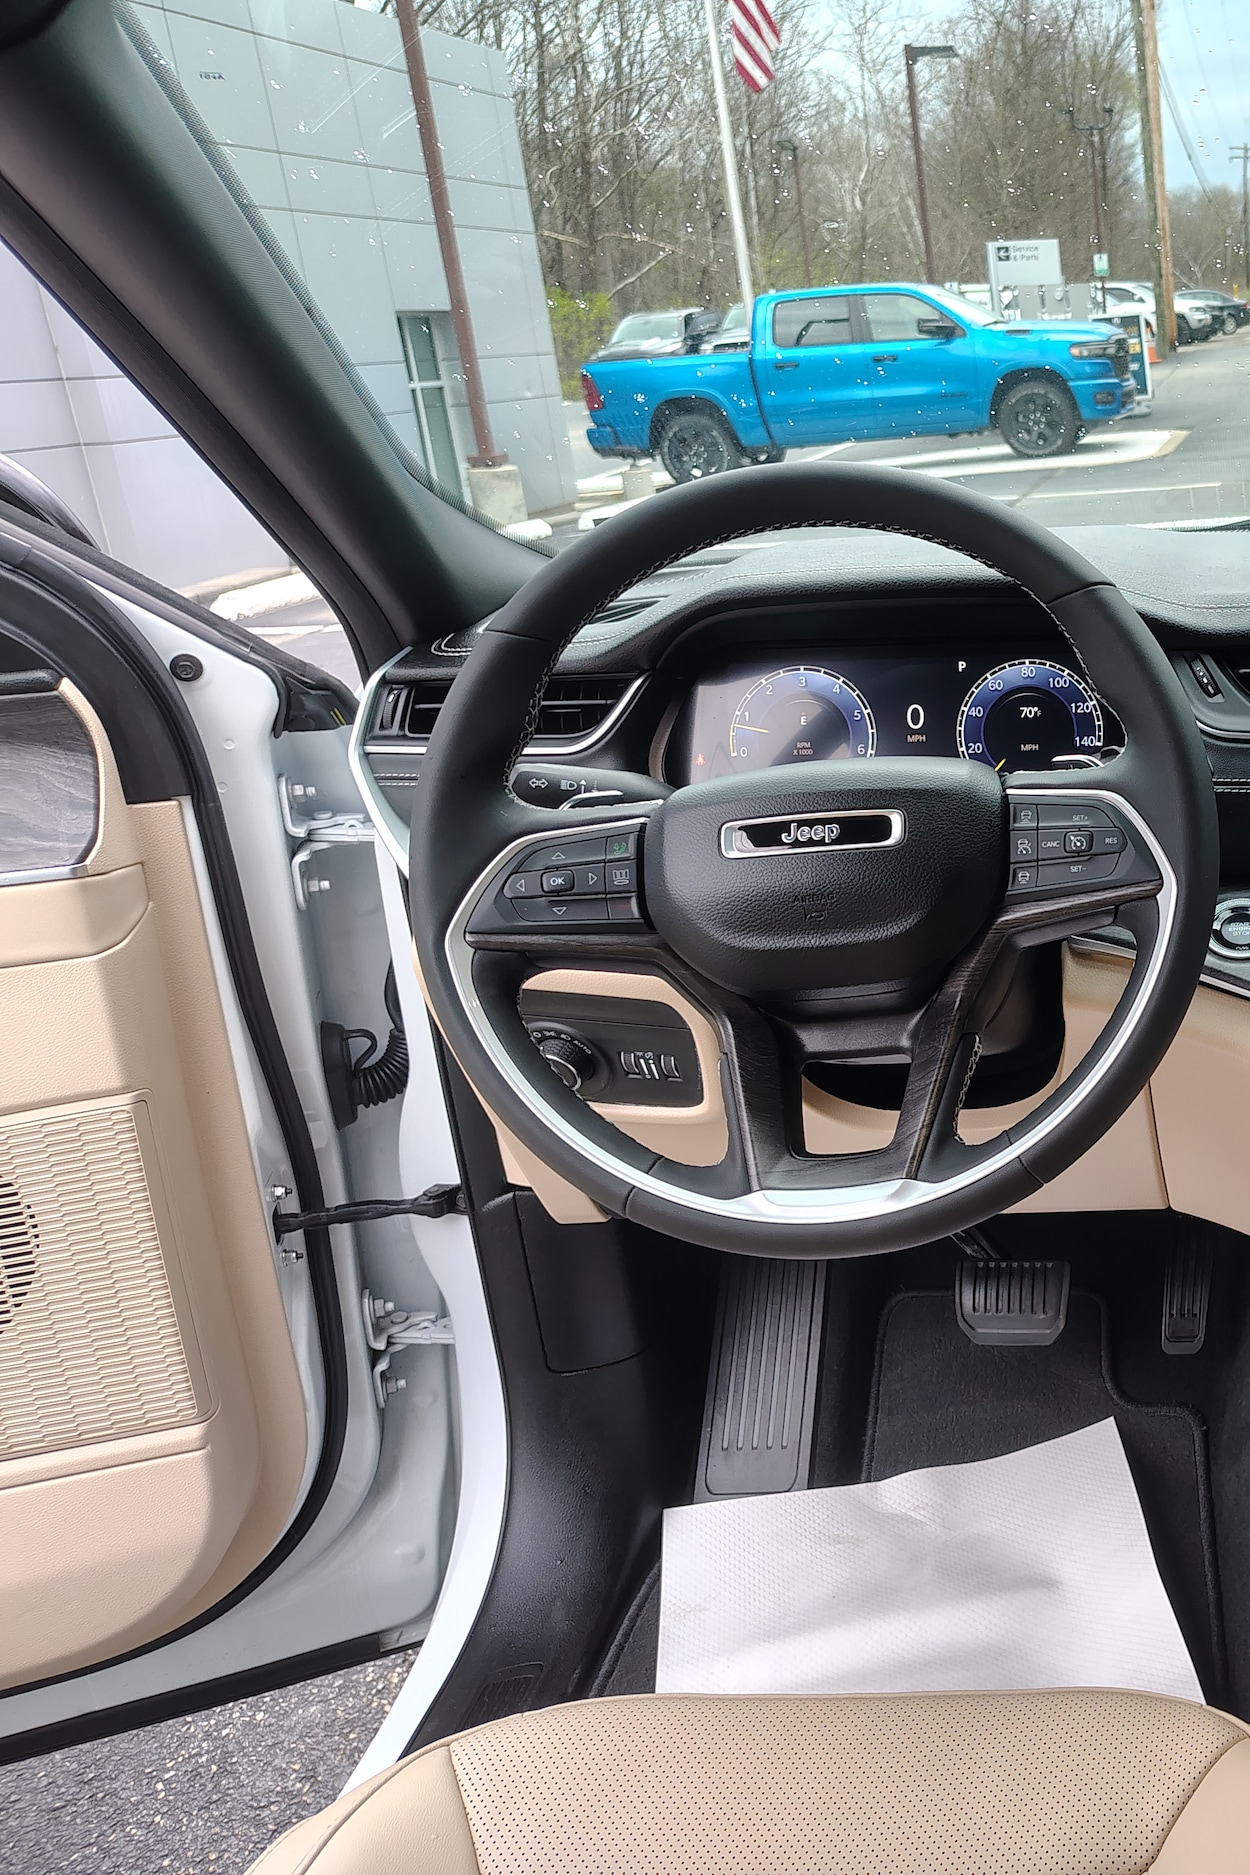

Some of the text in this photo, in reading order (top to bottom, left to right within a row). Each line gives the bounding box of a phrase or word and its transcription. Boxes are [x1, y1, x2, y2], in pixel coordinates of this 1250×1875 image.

[958, 661, 967, 672] P
[1021, 667, 1036, 678] 80
[799, 676, 806, 687] 3
[988, 680, 1003, 691] 60
[1048, 677, 1070, 689] 100
[766, 685, 773, 695] 2
[833, 684, 841, 694] 4
[968, 706, 983, 717] 40
[1070, 702, 1092, 714] 120
[744, 711, 750, 722] 1
[800, 716, 807, 725] E
[853, 710, 861, 720] 5
[906, 704, 925, 730] 0
[907, 734, 926, 743] MPH
[1074, 736, 1096, 747] 140
[796, 741, 811, 749] RPM
[857, 744, 865, 755] 6
[967, 743, 983, 754] 20
[1021, 743, 1039, 751] MPH
[740, 747, 748, 758] 0
[781, 822, 841, 843] Jeep
[1041, 840, 1060, 848] CANC
[1104, 837, 1118, 845] RES
[550, 876, 566, 887] OK
[793, 894, 835, 904] AIRBAG
[573, 1040, 592, 1055] AUTO
